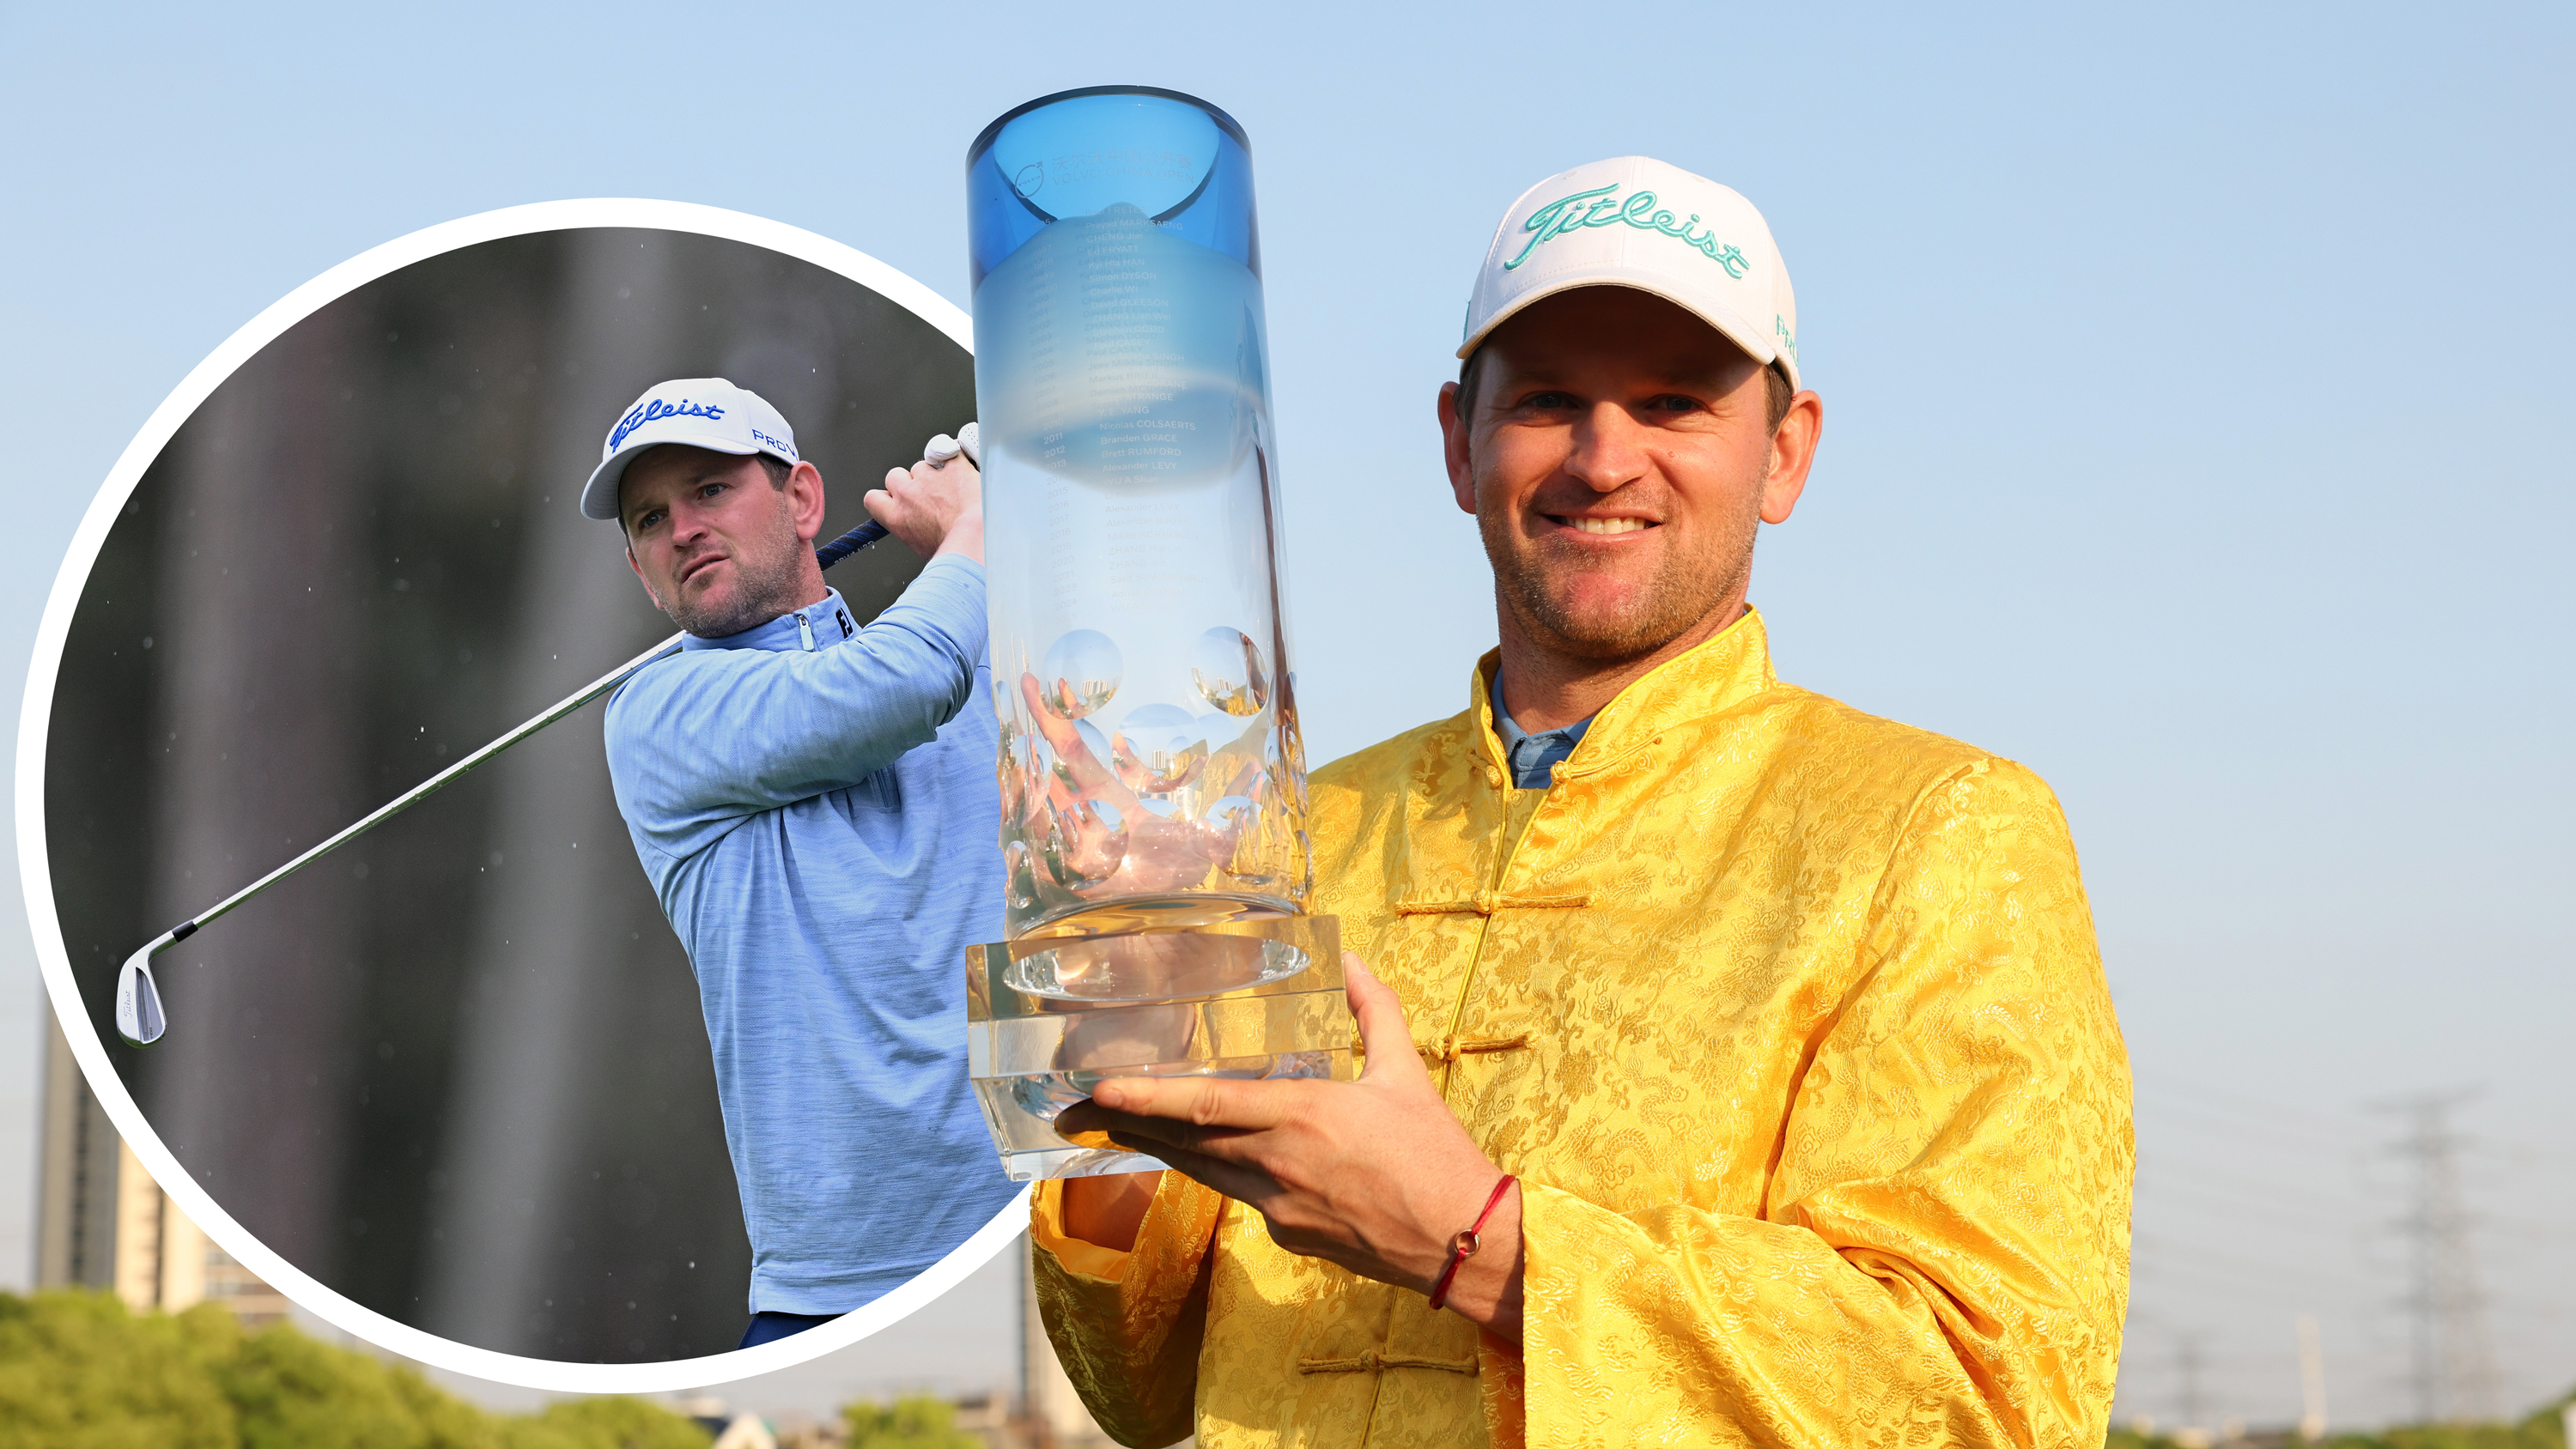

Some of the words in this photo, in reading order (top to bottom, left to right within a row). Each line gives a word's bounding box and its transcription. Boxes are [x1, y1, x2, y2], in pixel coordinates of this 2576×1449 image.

[1052, 149, 1193, 172] 沃尔沃中国公开赛
[1018, 175, 1041, 187] VOLVO
[1053, 168, 1101, 185] VOLVO
[1106, 167, 1152, 179] CHINA
[1157, 169, 1194, 184] OPEN
[1085, 221, 1116, 230] Prayad
[1120, 219, 1183, 230] MARKSAENG
[1504, 183, 1750, 280] Titleist
[1087, 233, 1123, 243] CHENG
[1089, 262, 1103, 270] Kyi
[1090, 274, 1119, 282] Simon
[1090, 286, 1122, 295] Charlie
[1091, 300, 1117, 309] David
[1120, 299, 1169, 307] GLEESON
[1092, 312, 1129, 323] ZHANG
[1121, 406, 1150, 415] YANG
[609, 398, 725, 454] Titleist
[1043, 432, 1064, 445] 2011
[1100, 421, 1134, 431] Nicolas
[1136, 420, 1196, 431] COLSAERTS
[1044, 445, 1066, 458] 2012
[1101, 435, 1140, 445] Branden
[1143, 433, 1178, 442] GRACE
[1045, 458, 1066, 471] 2013
[1102, 448, 1125, 458] Brett
[1127, 447, 1182, 457] RUMFORD
[1102, 462, 1148, 472] Alexander
[1151, 461, 1178, 470] LEVY
[1047, 486, 1068, 500] 2015
[1124, 476, 1133, 484] A
[1134, 475, 1158, 484] Shun
[1048, 500, 1070, 513] 2016
[1048, 513, 1070, 528] 2017
[1105, 503, 1151, 514] Alexander
[1155, 502, 1181, 512] LEVY
[1049, 527, 1071, 542] 2018
[1106, 517, 1152, 528] Alexander
[1050, 541, 1072, 555] 2019
[1107, 531, 1137, 542] Mikko
[1139, 530, 1200, 541] KORHONEN
[1051, 555, 1075, 569] 2020
[1108, 544, 1146, 555] ZHANG
[1052, 569, 1075, 583] 2021
[1109, 559, 1147, 571] ZHANG
[1054, 583, 1078, 597] 2023
[1054, 597, 1078, 612] 2024
